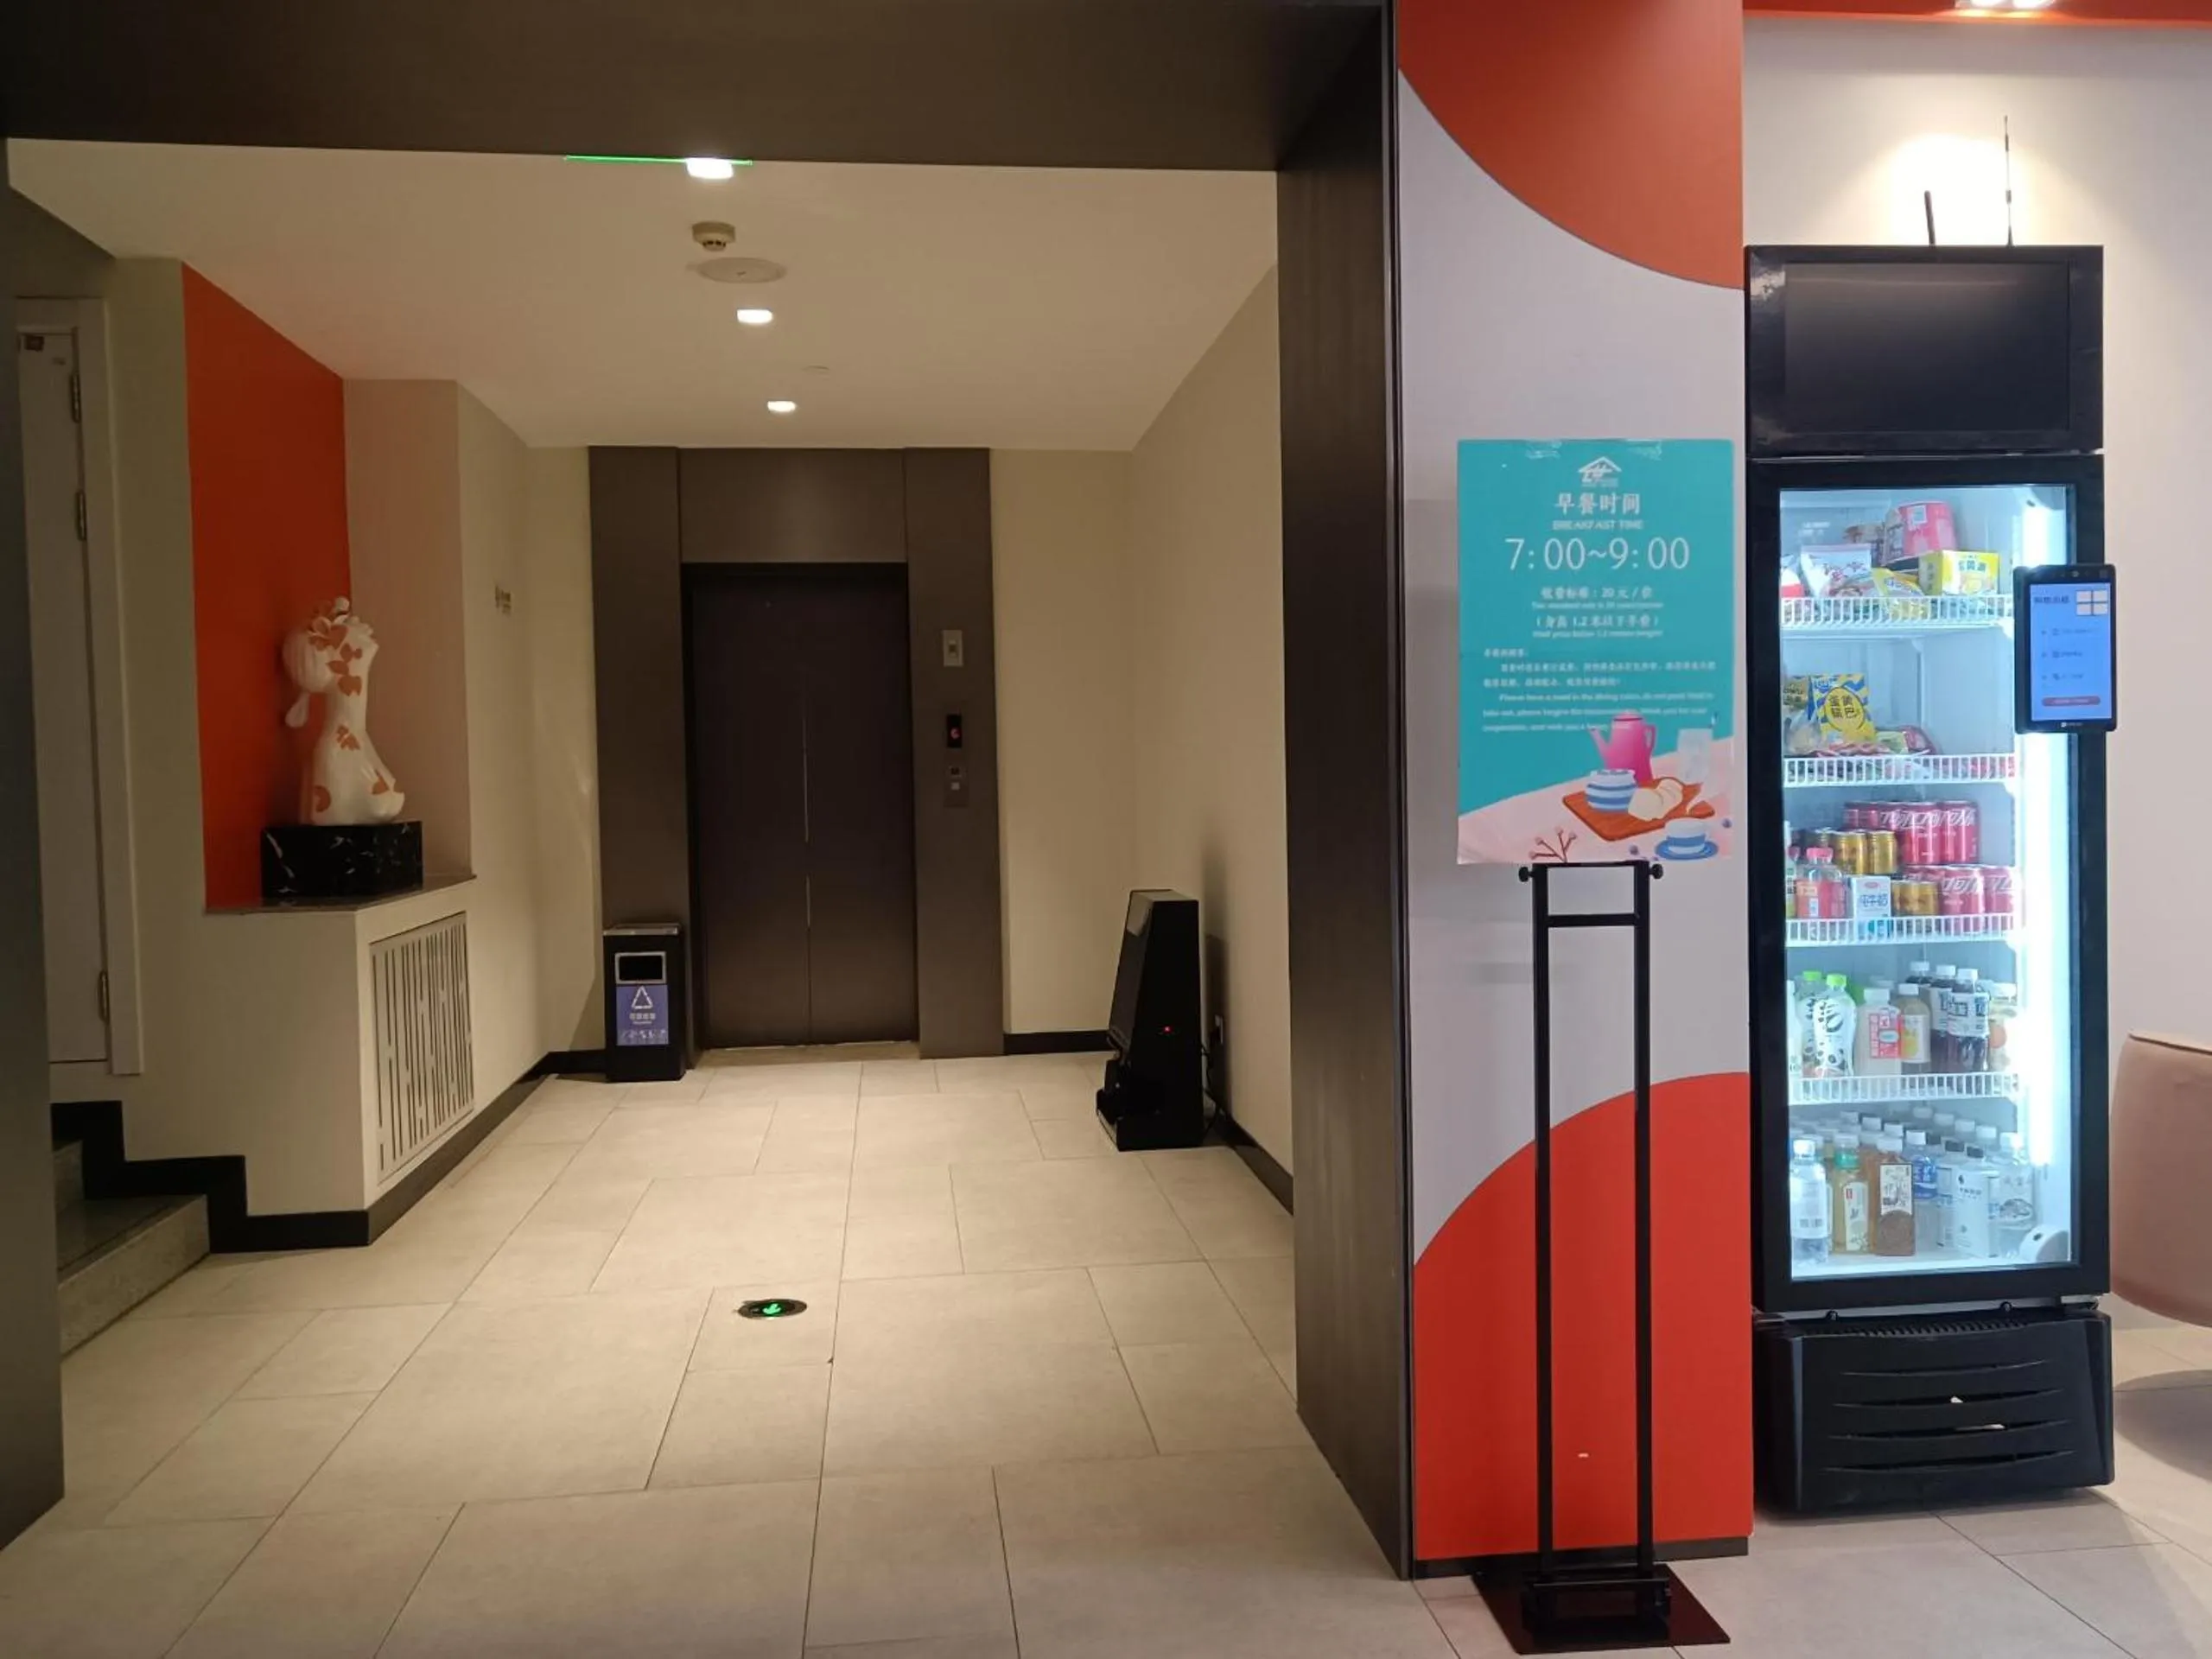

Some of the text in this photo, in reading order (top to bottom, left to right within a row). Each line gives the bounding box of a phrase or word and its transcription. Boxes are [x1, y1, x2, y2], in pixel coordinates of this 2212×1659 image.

[1553, 492, 1641, 516] 早餐时间
[1552, 520, 1644, 531] BREAKFAST TIME
